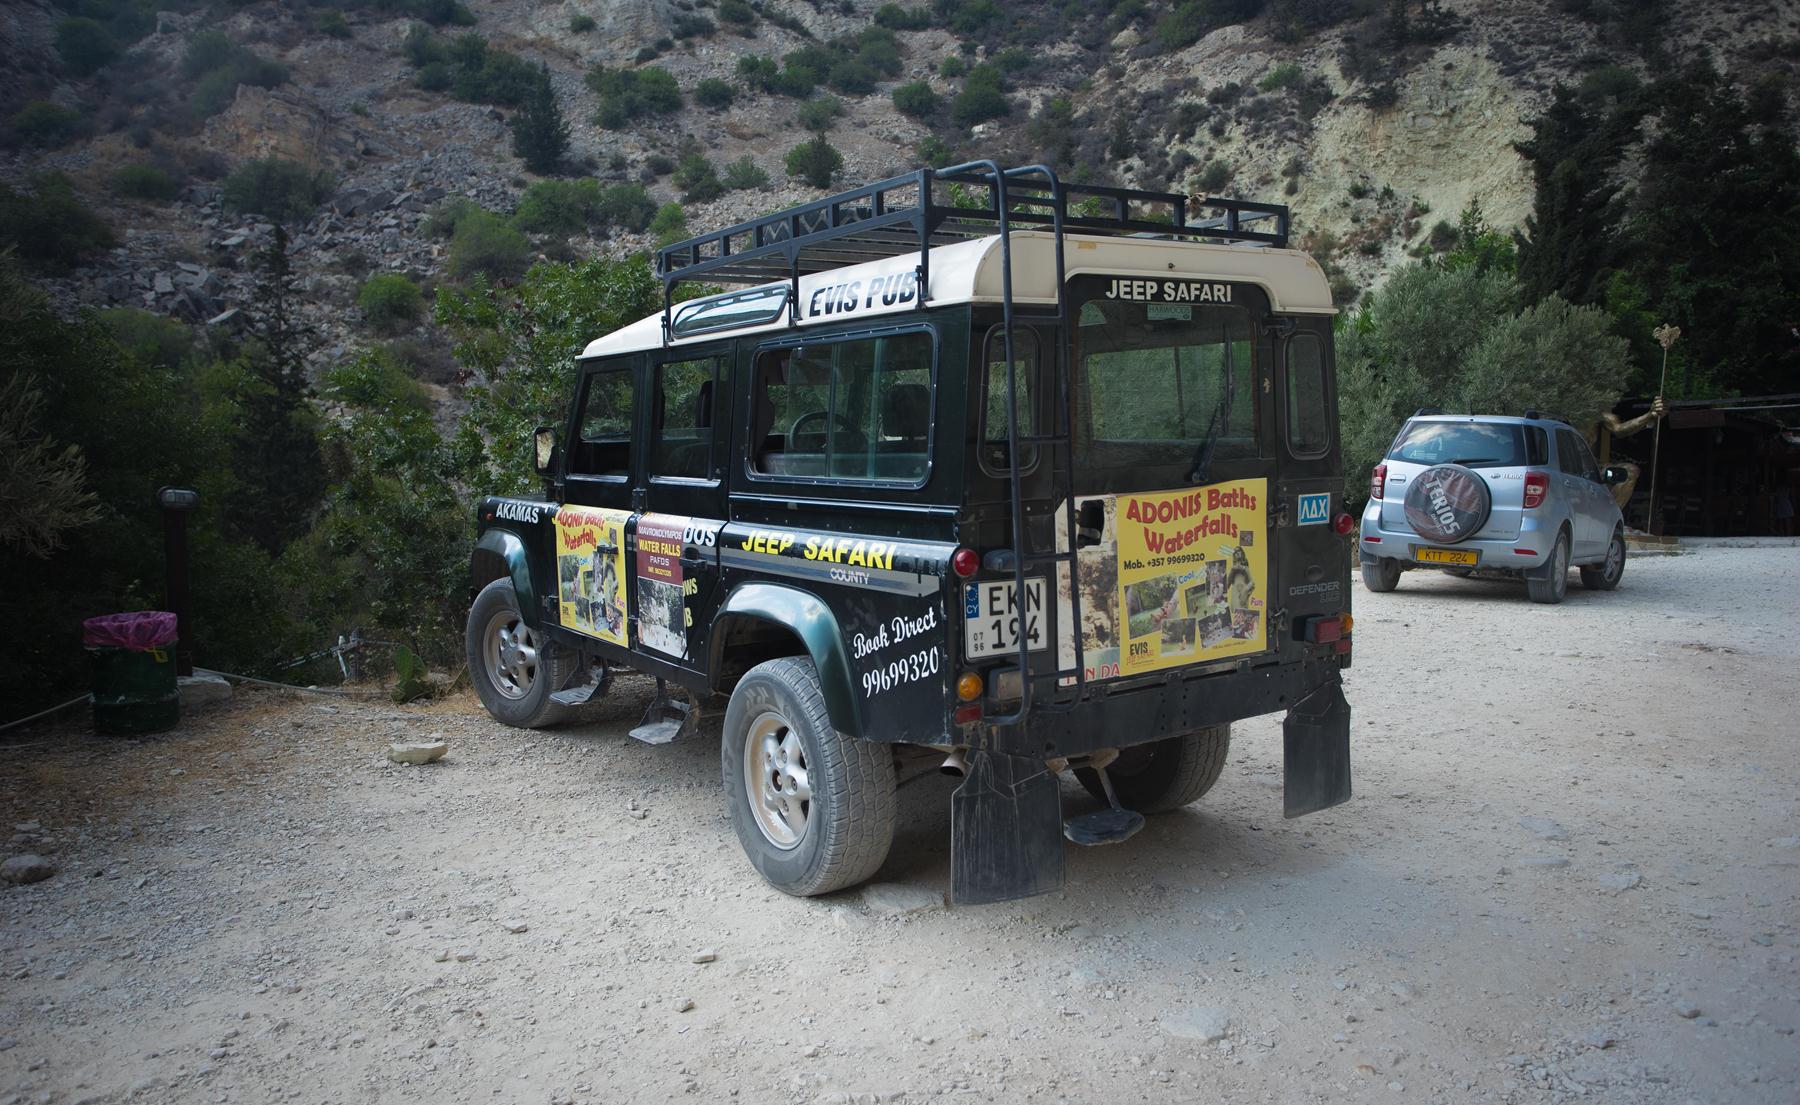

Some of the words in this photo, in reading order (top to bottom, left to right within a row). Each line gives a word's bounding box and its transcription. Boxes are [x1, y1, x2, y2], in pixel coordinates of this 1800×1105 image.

[809, 281, 861, 317] EVIS
[866, 271, 917, 308] PUB
[1105, 279, 1158, 300] JEEP
[1163, 281, 1232, 302] SAFARI
[496, 502, 540, 524] AKAMAS
[1126, 492, 1202, 524] ADONIS
[1207, 487, 1257, 511] Baths
[1424, 477, 1461, 536] TERIOS
[638, 538, 660, 552] WATER
[660, 541, 681, 557] FALLS
[1143, 512, 1239, 555] Waterfalls
[741, 530, 796, 555] JEEP
[803, 534, 897, 570] SAFARI
[1123, 560, 1145, 571] Mob.
[1147, 557, 1165, 569] +357
[1167, 552, 1206, 565] 99699320
[1425, 551, 1442, 561] KTT
[1449, 553, 1468, 563] 224
[829, 567, 871, 585] COUNTY
[1289, 580, 1340, 596] DEFENDER
[966, 604, 979, 614] CY
[989, 582, 1041, 617] EKN
[853, 623, 890, 659] Book
[891, 606, 937, 644] Direct
[991, 615, 1040, 650] 194
[1129, 641, 1149, 656] EVIS
[862, 645, 939, 698] 99699320
